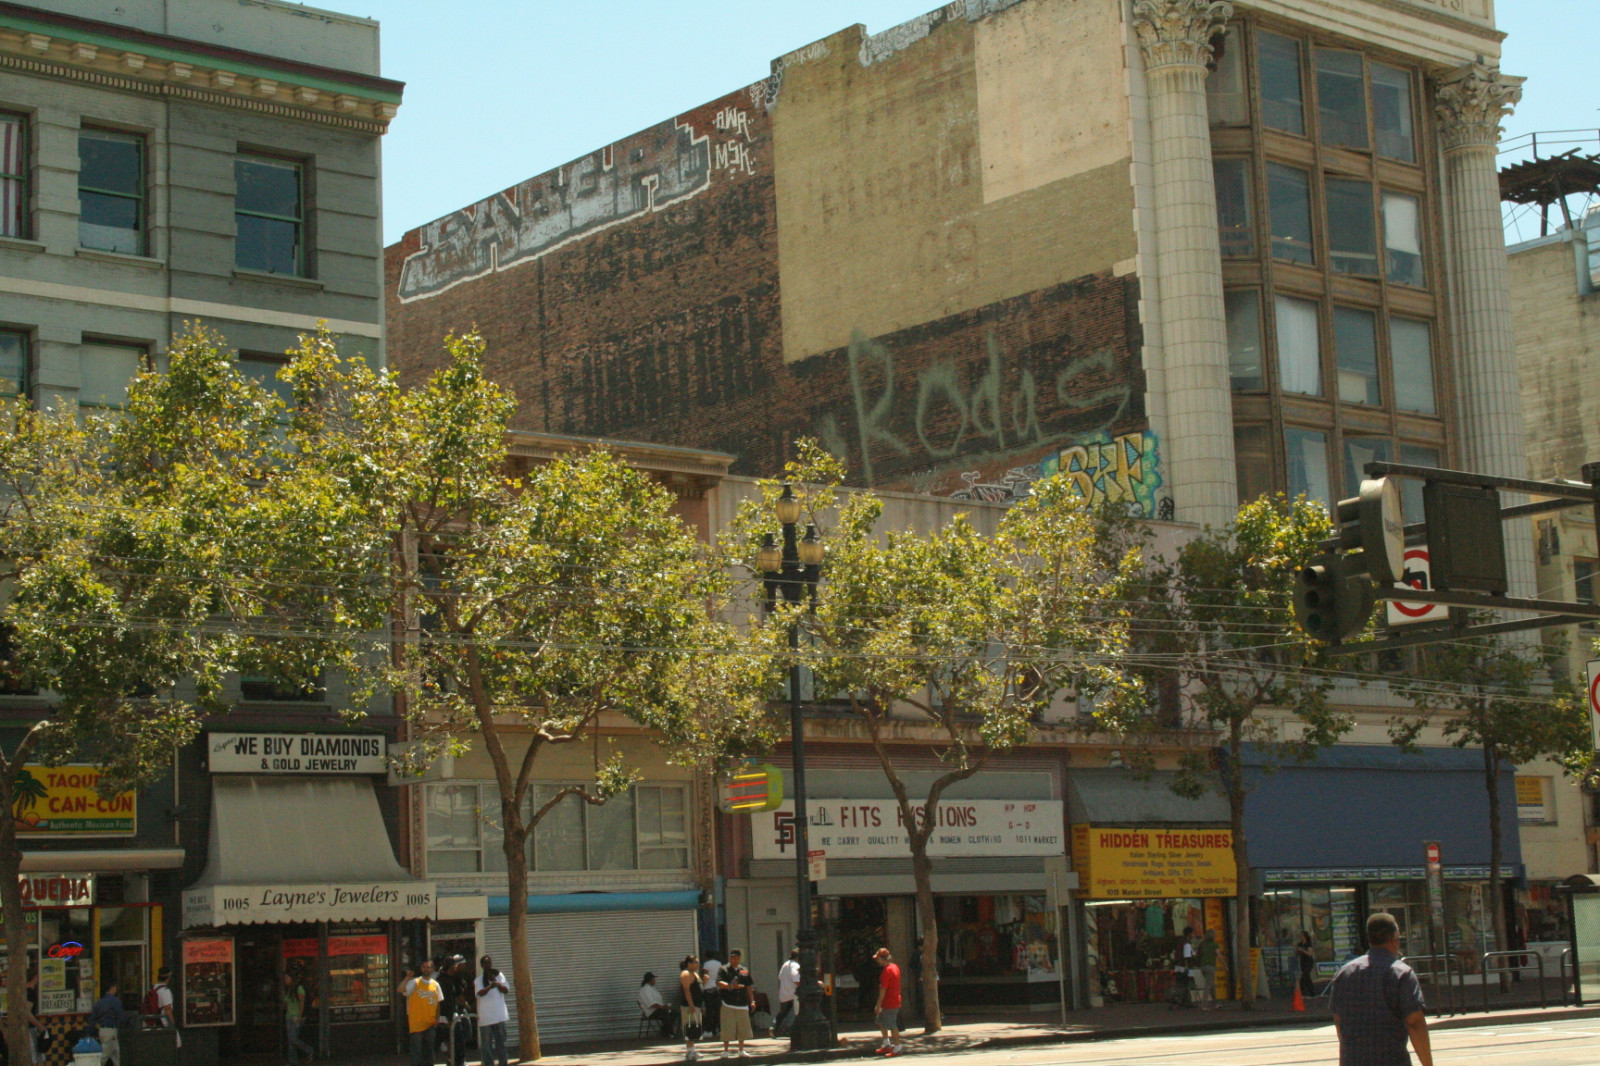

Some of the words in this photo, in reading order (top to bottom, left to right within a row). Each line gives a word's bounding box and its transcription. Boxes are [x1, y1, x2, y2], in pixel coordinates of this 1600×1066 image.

[715, 140, 756, 175] MSK
[234, 737, 257, 755] WE
[264, 737, 293, 756] BUY
[301, 738, 379, 756] DIAMONDS
[261, 758, 269, 770] &
[273, 759, 300, 770] GOLD
[305, 759, 357, 771] JEWELRY
[85, 820, 114, 829] Mexican
[116, 820, 132, 829] Food
[840, 806, 881, 828] FITS
[897, 806, 978, 828] FSIONS
[837, 837, 860, 846] CARRY
[867, 836, 899, 845] QUALITY
[968, 835, 1002, 844] CLOTHING
[1015, 835, 1032, 844] 1011
[1033, 836, 1058, 845] MARKET
[1100, 833, 1149, 848] HIDDEN
[1156, 833, 1230, 849] TREASURES
[19, 878, 90, 900] QUERIA
[223, 898, 250, 911] 1005
[259, 889, 326, 911] Layne's
[329, 885, 399, 907] Jewelers
[406, 893, 431, 906] 1005
[48, 944, 84, 958] Open
